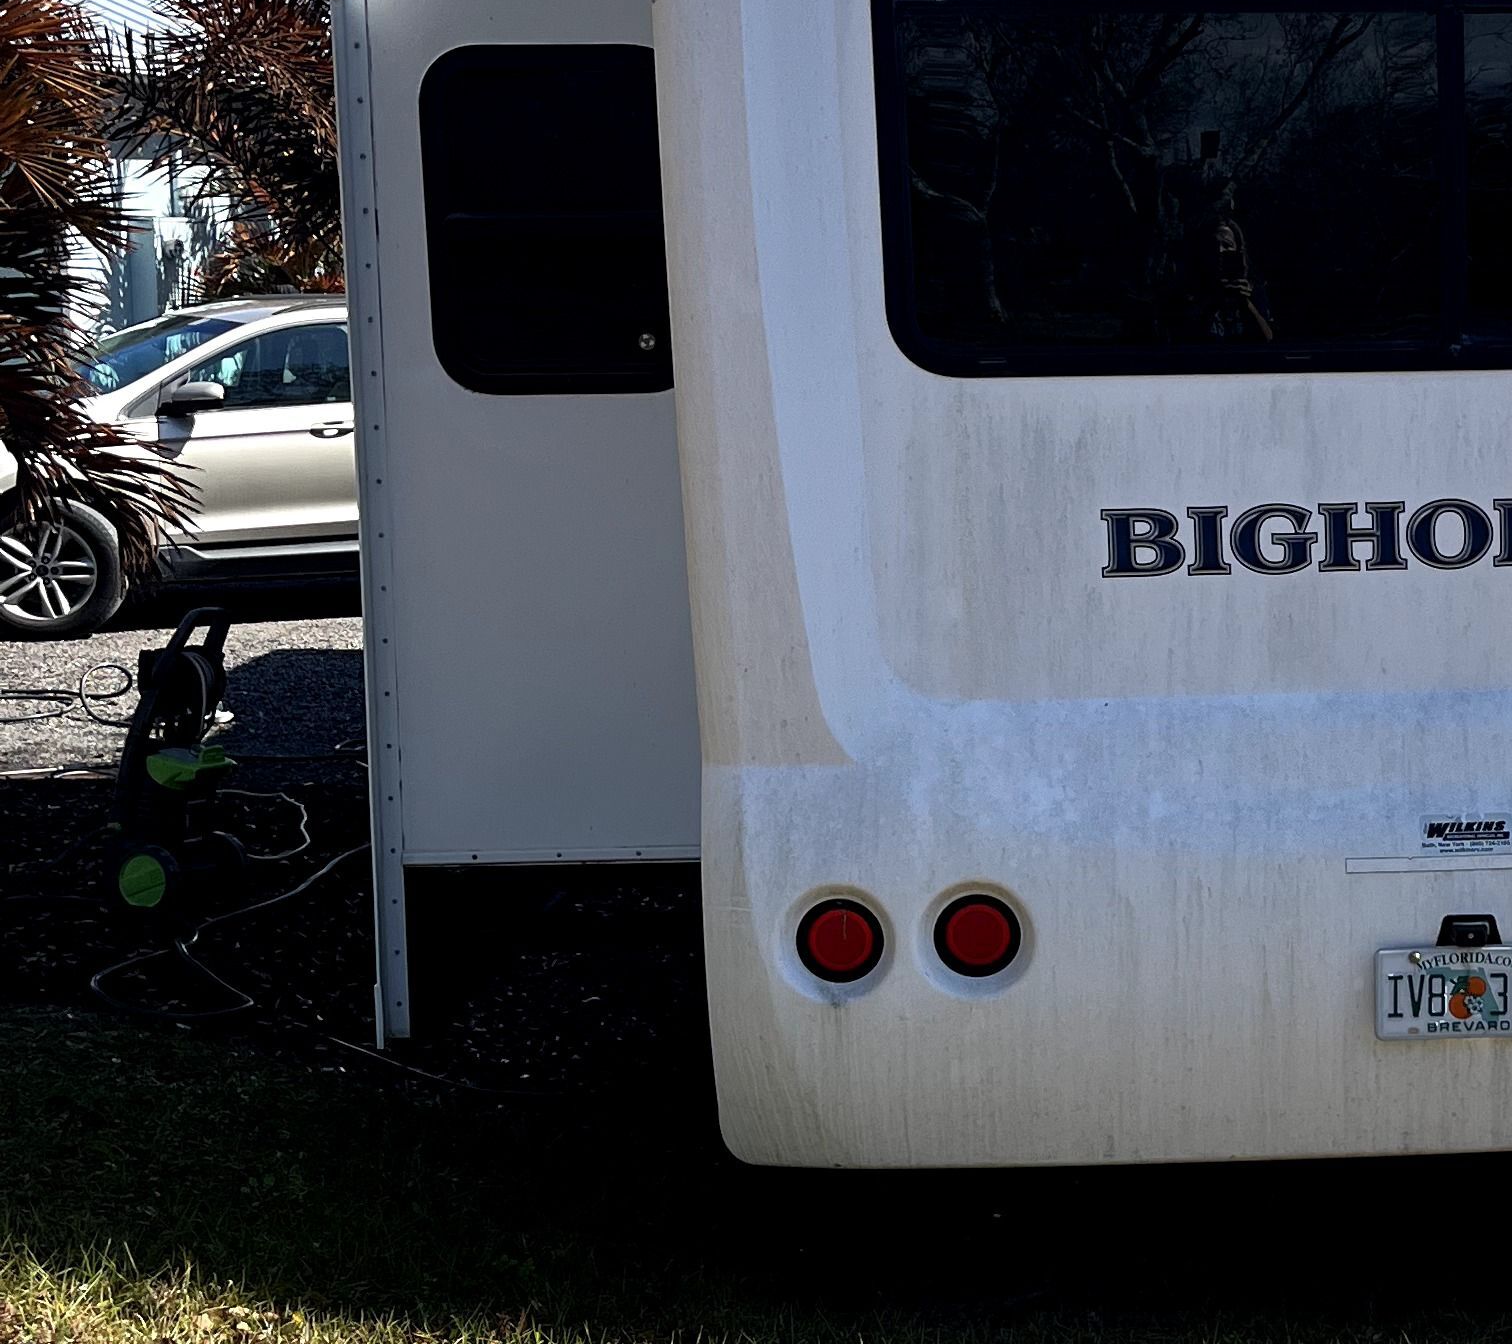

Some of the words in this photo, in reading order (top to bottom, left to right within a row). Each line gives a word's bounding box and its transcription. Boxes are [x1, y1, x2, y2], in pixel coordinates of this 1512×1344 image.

[1427, 821, 1506, 838] WILKINS
[1387, 974, 1446, 1018] IV8
[1427, 1020, 1511, 1033] BREVARD
